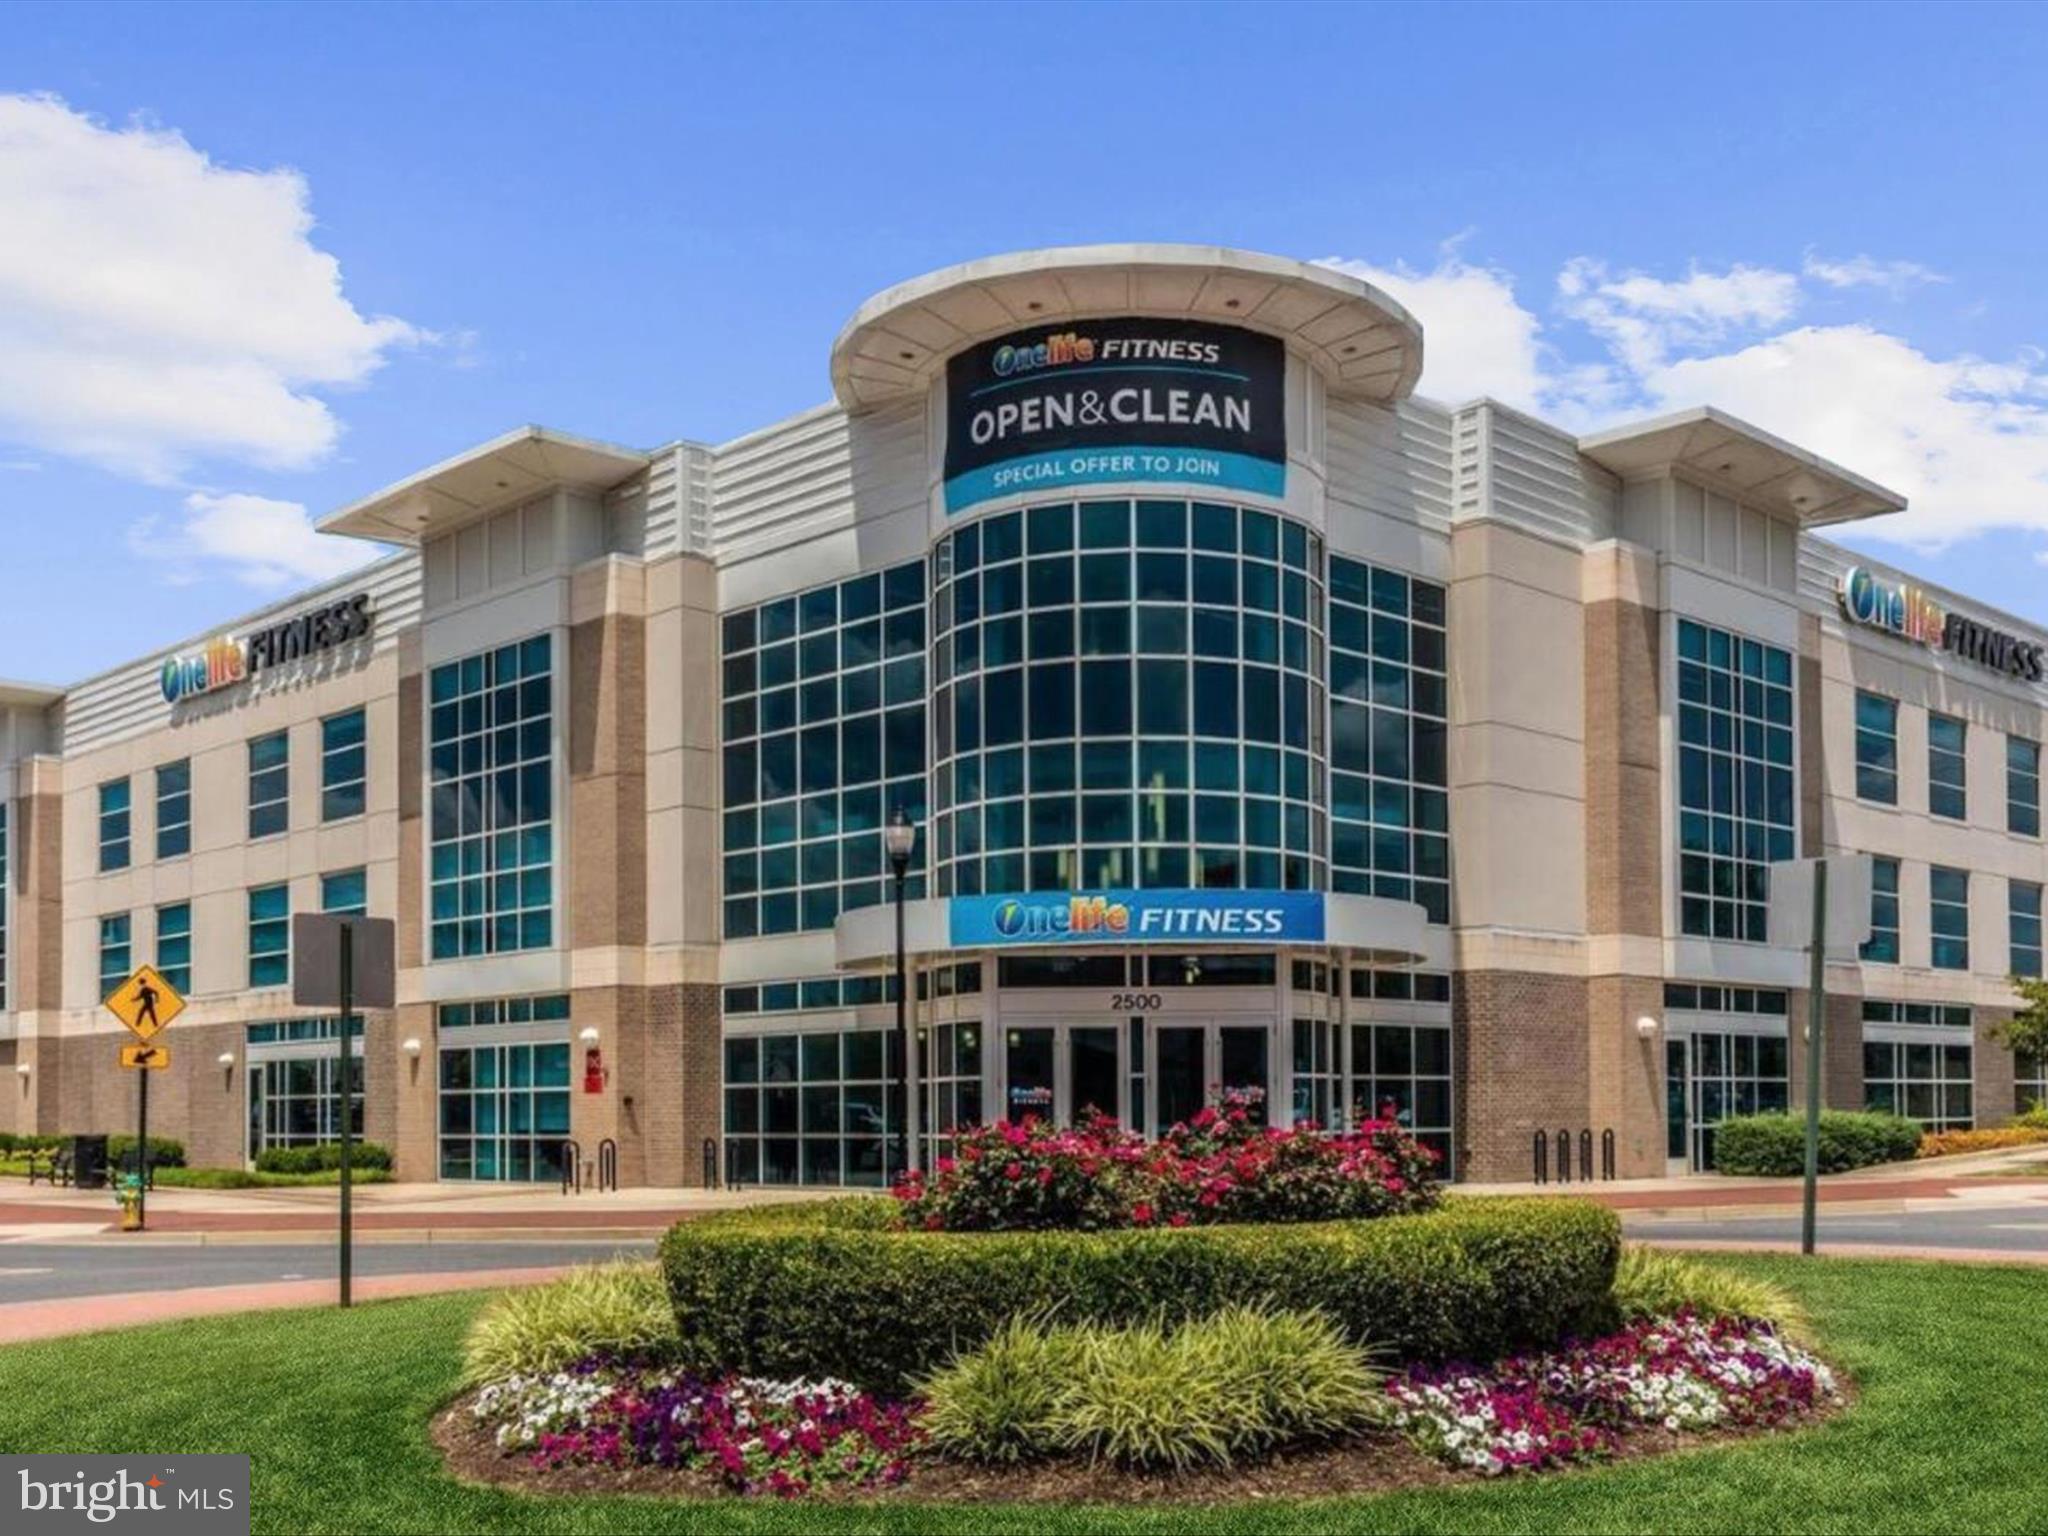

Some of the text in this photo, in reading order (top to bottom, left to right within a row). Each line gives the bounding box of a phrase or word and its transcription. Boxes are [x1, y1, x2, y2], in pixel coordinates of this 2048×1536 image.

[993, 332, 1219, 376] Onelife FITNESS
[970, 388, 1250, 444] OPEN&CLEAN
[993, 455, 1219, 487] SPECIAL OFFER TO JOIN
[160, 593, 370, 703] Onelife FITNESS
[1944, 613, 2043, 682] FITNESS
[994, 896, 1284, 937] Onelife FITNESS
[1111, 994, 1162, 1011] 2500
